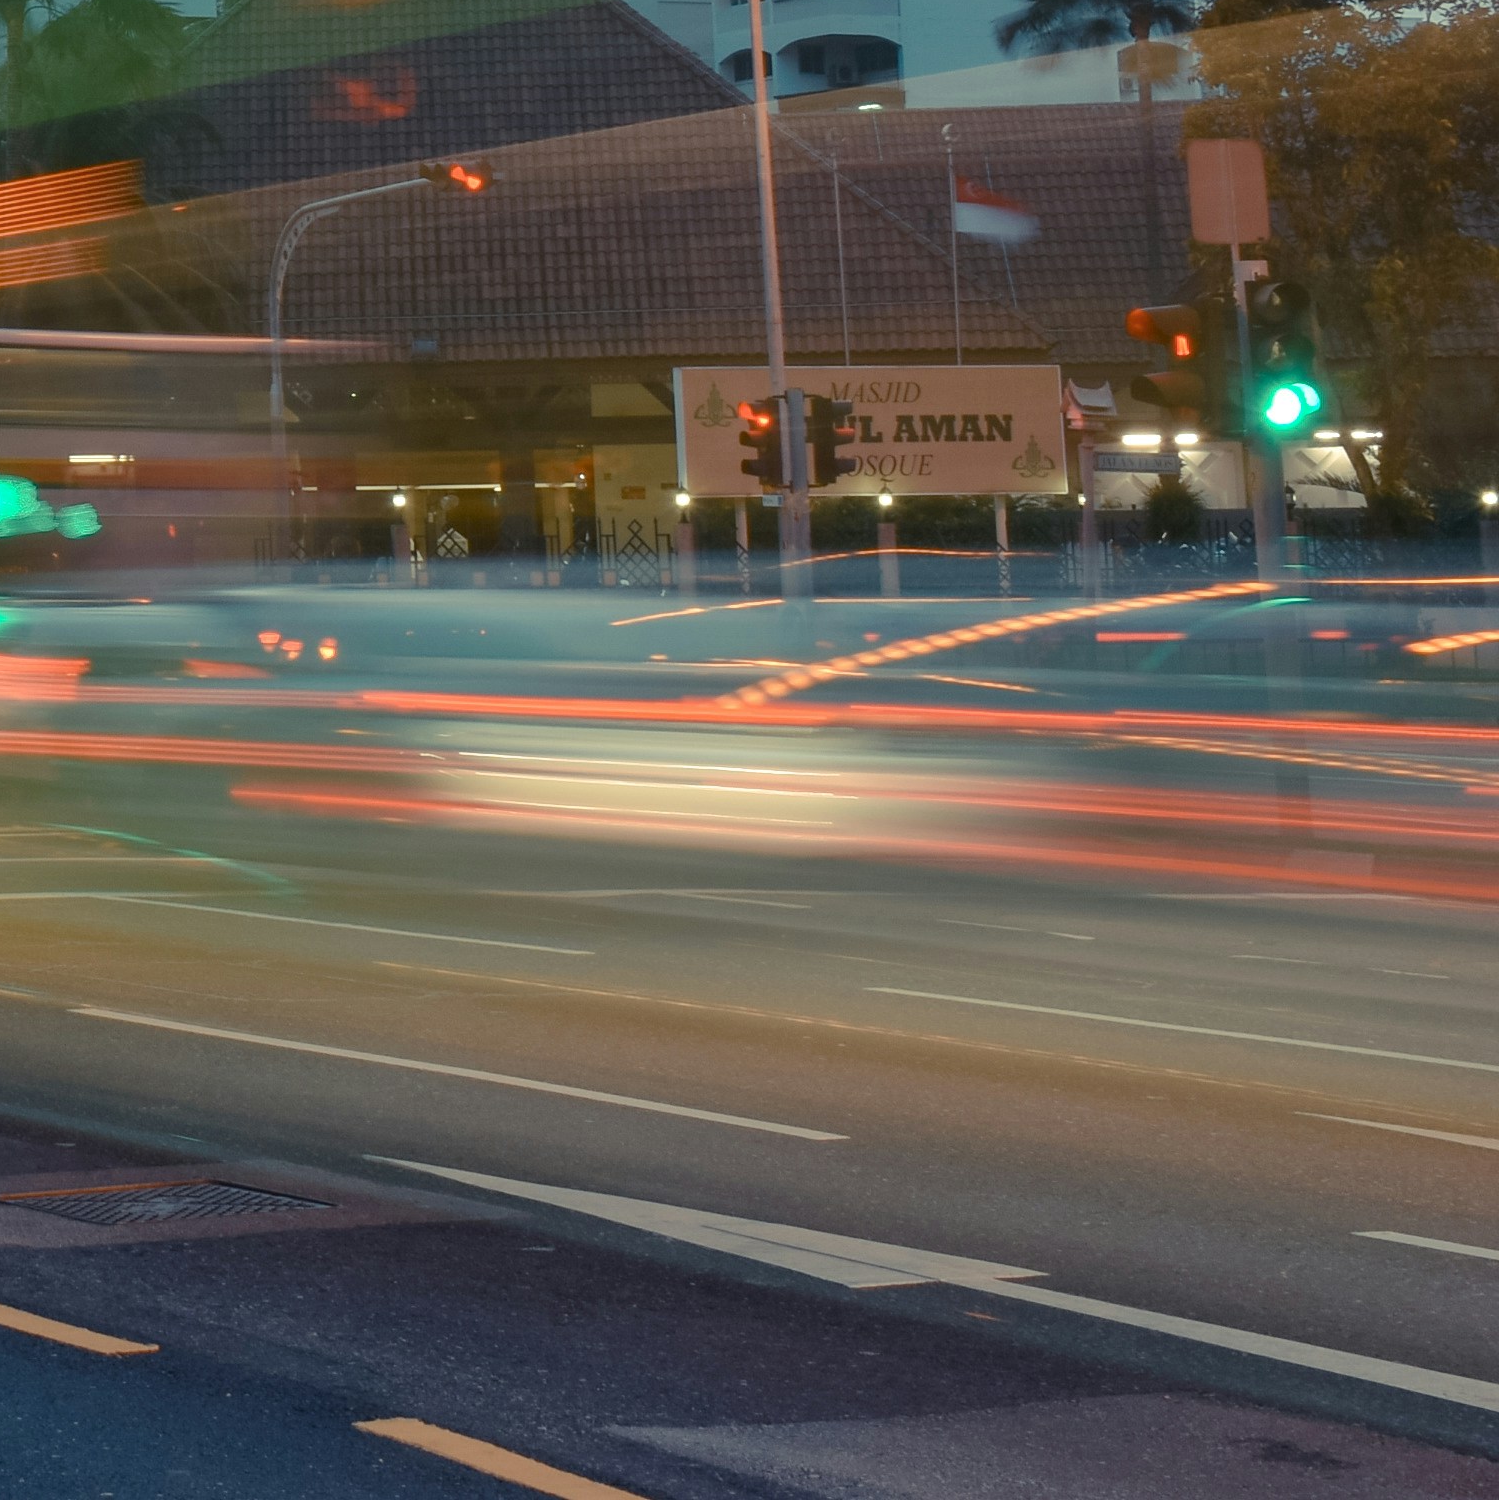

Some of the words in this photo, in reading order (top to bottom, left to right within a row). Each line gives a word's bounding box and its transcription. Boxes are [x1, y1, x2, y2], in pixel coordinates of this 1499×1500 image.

[830, 381, 922, 403] MASJID
[892, 413, 1013, 443] AMAN
[842, 454, 934, 483] OSQUE
